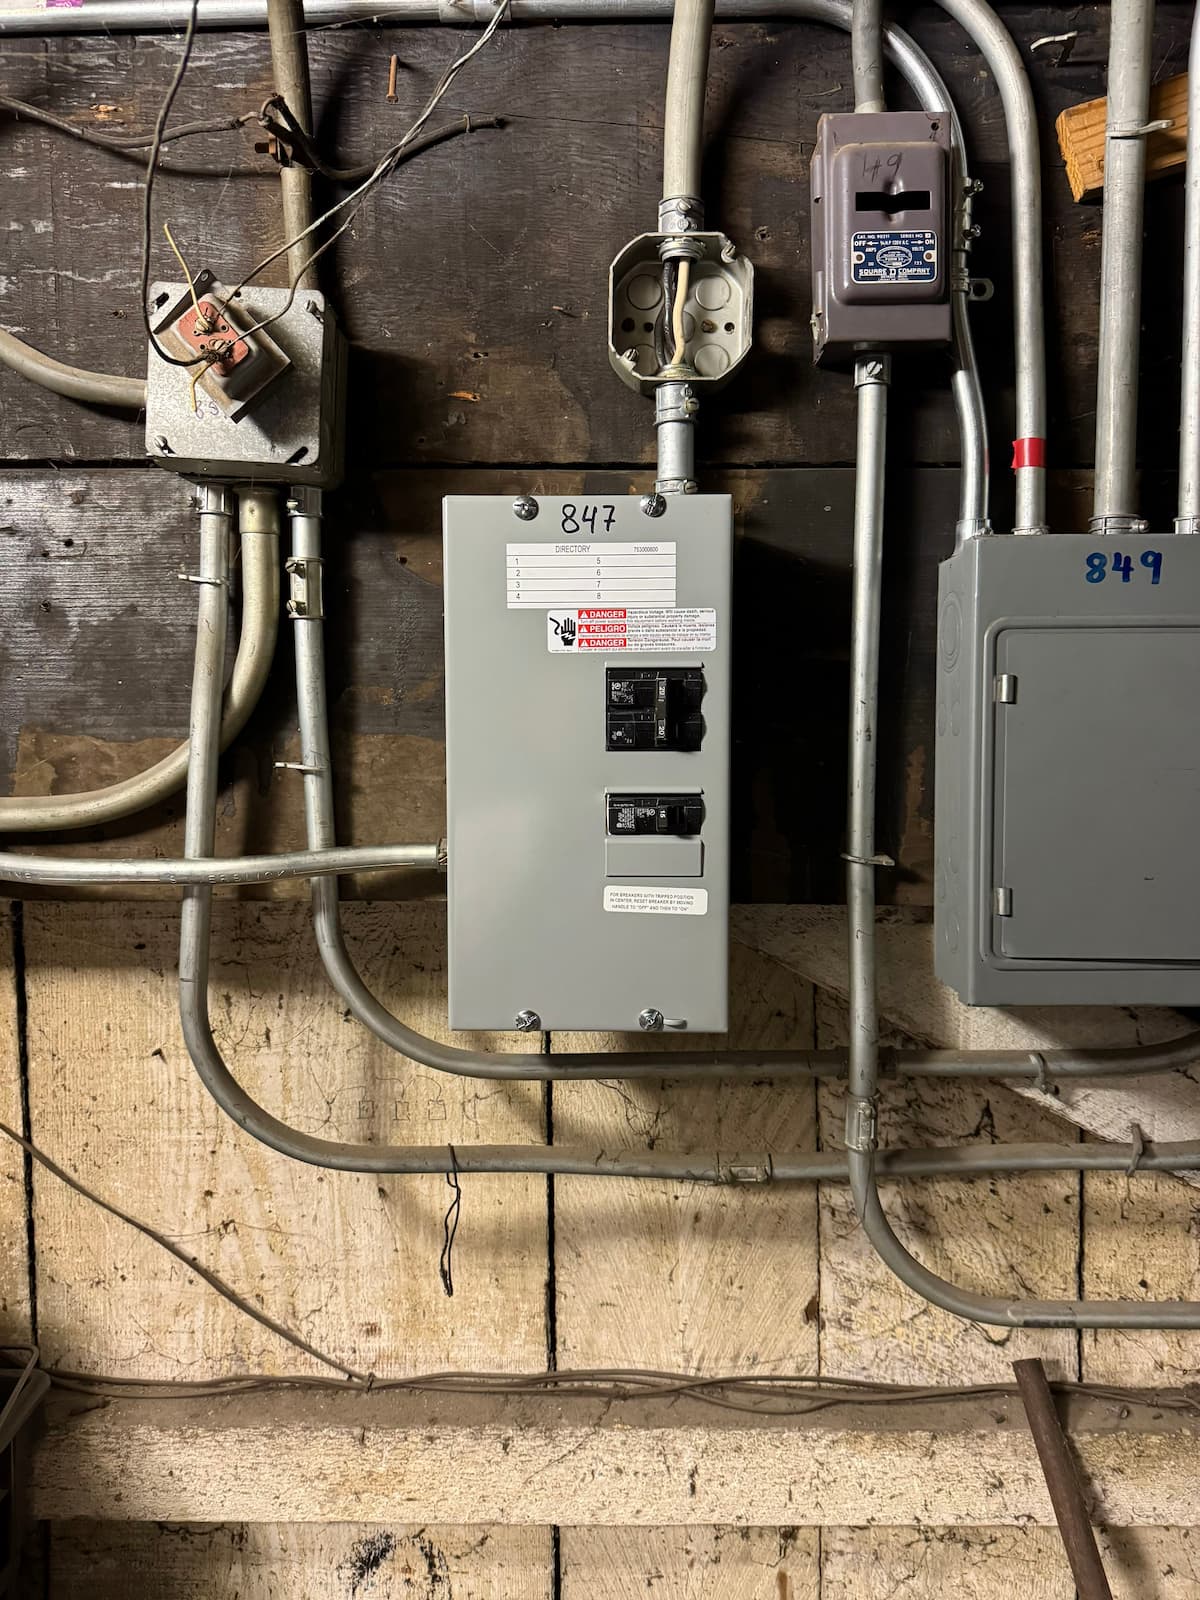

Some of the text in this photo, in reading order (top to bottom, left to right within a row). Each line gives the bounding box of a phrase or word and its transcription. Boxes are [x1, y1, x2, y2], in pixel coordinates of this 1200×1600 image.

[858, 268, 887, 276] SQUARE
[562, 504, 616, 534] 847
[556, 545, 590, 553] DIRECTORY
[1086, 550, 1162, 584] 849
[659, 686, 666, 695] 20
[658, 726, 665, 736] 20
